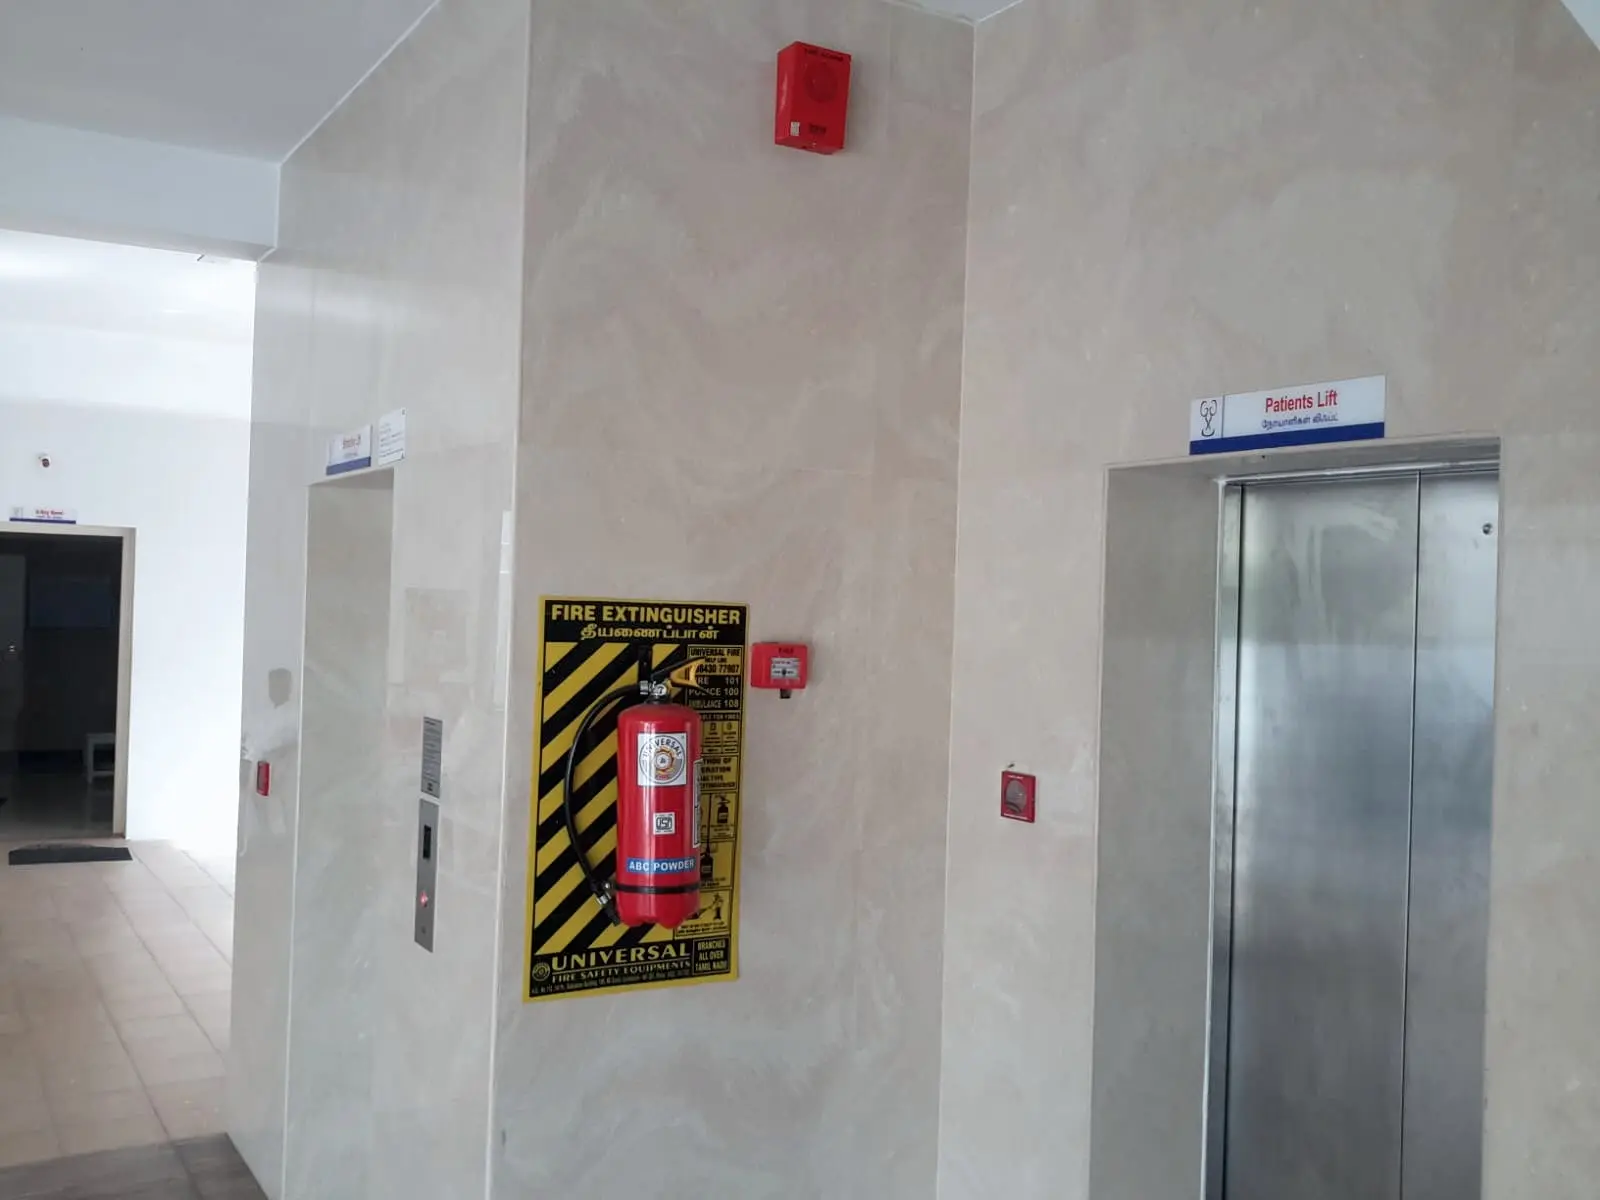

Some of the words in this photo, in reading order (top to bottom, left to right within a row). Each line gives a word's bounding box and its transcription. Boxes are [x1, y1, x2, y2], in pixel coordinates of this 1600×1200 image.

[1265, 394, 1313, 413] Patients
[1317, 389, 1338, 408] Lift
[551, 604, 596, 621] FIRE
[602, 606, 740, 624] EXTINGUISHER
[690, 648, 725, 657] UNIVERSAL
[726, 648, 740, 657] FIRE
[724, 676, 739, 686] 101
[724, 687, 739, 697] 100
[723, 699, 739, 709] 108
[629, 860, 650, 871] ABC
[653, 859, 694, 871] POWDER
[697, 939, 726, 950] BRANCHES
[551, 943, 691, 971] UNIVERSAL
[699, 951, 709, 960] ALL
[709, 949, 724, 960] OVER
[552, 972, 576, 983] FIRE
[580, 967, 620, 979] SAFETY
[624, 960, 691, 974] EQUIPMENTS
[695, 961, 711, 971] TAMIL
